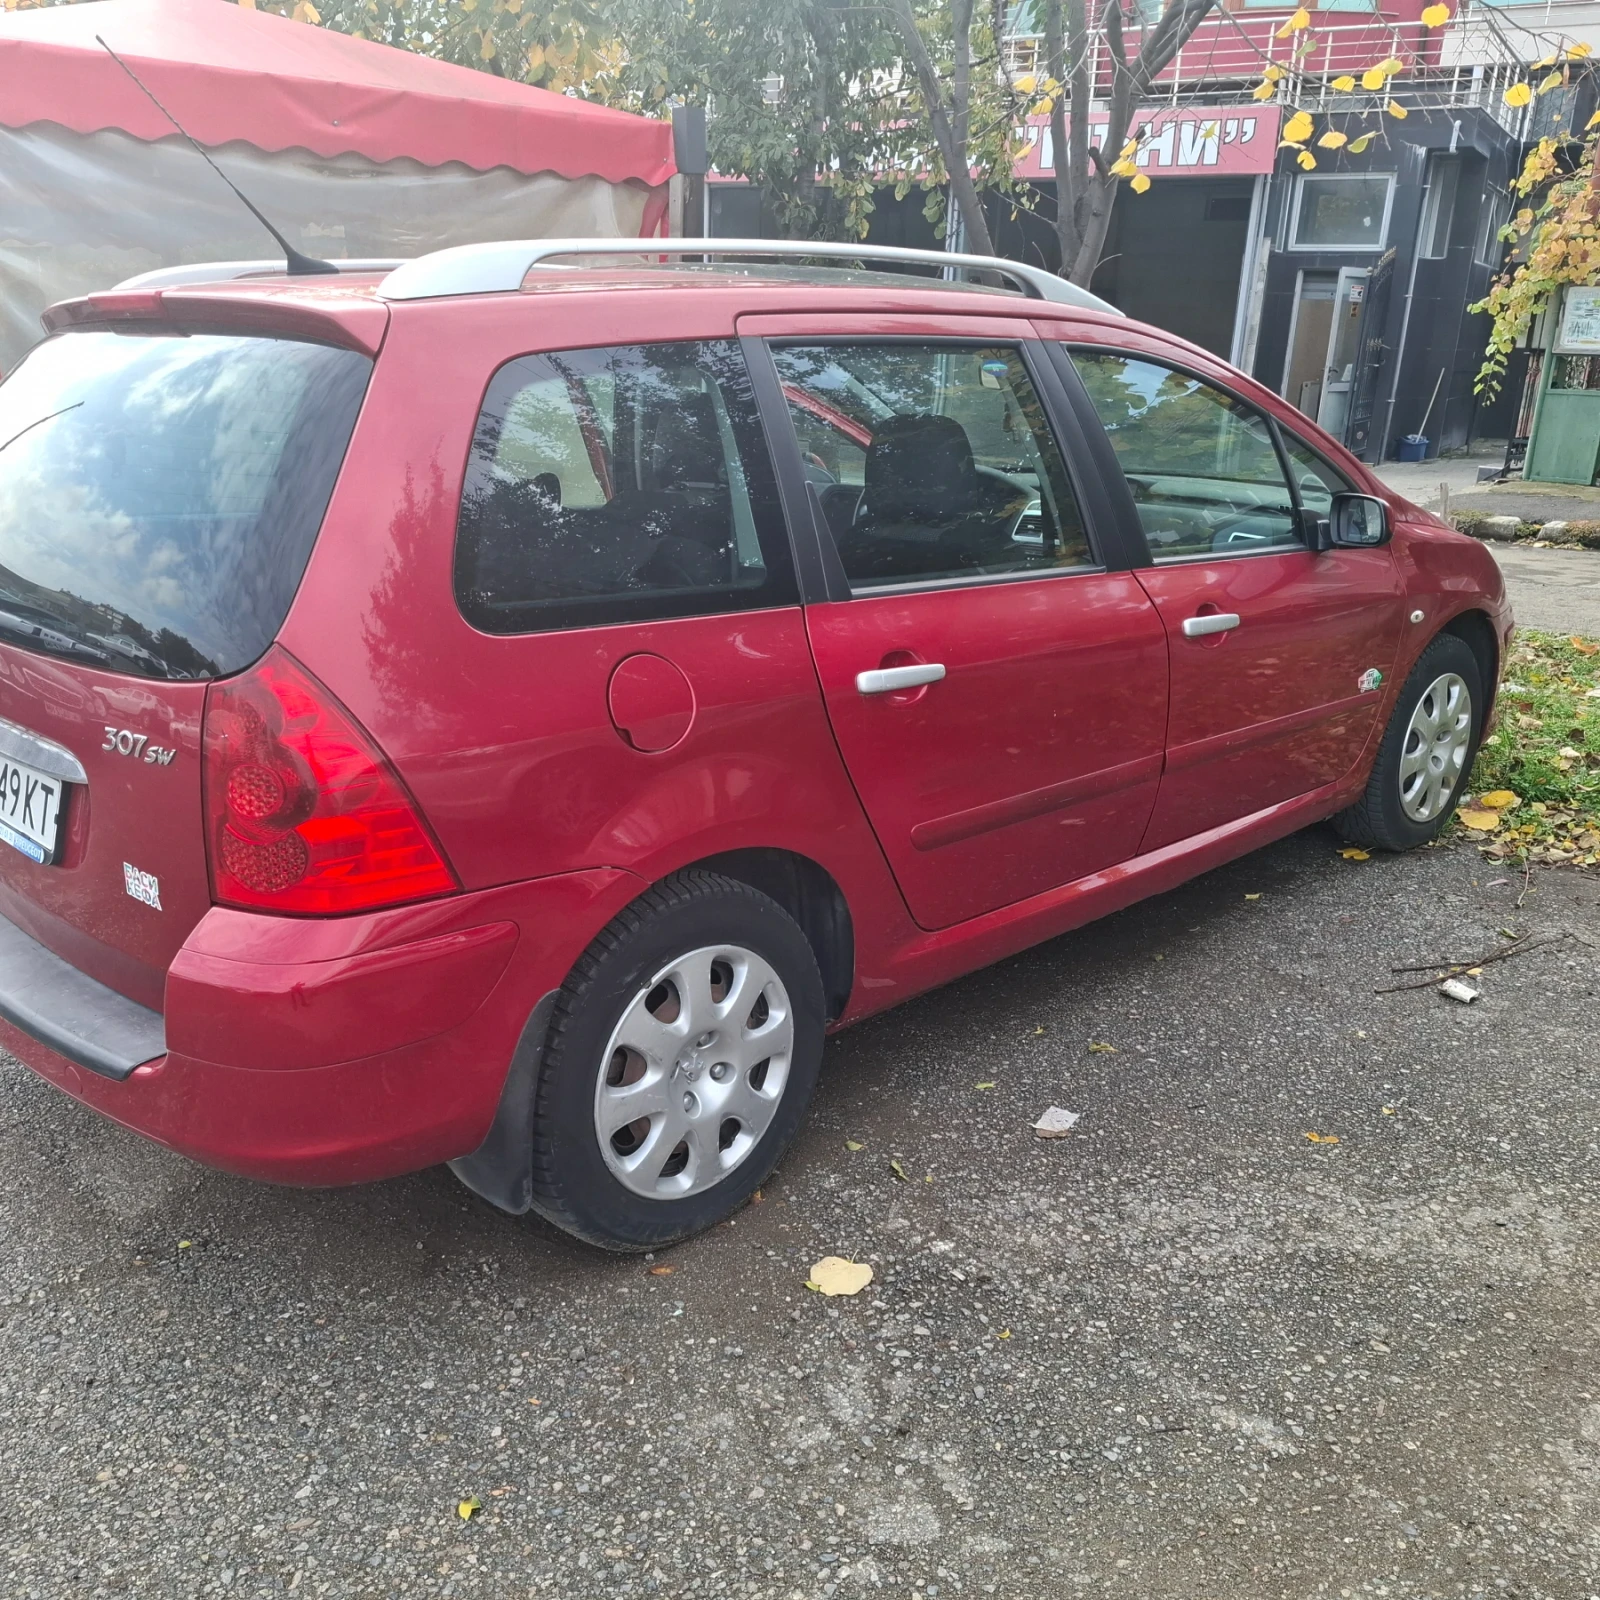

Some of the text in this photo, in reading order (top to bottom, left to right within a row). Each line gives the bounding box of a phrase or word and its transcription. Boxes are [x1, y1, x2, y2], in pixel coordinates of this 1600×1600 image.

[101, 726, 148, 758] 307
[124, 863, 158, 893] БАСИ
[127, 879, 161, 910] КЕФА
